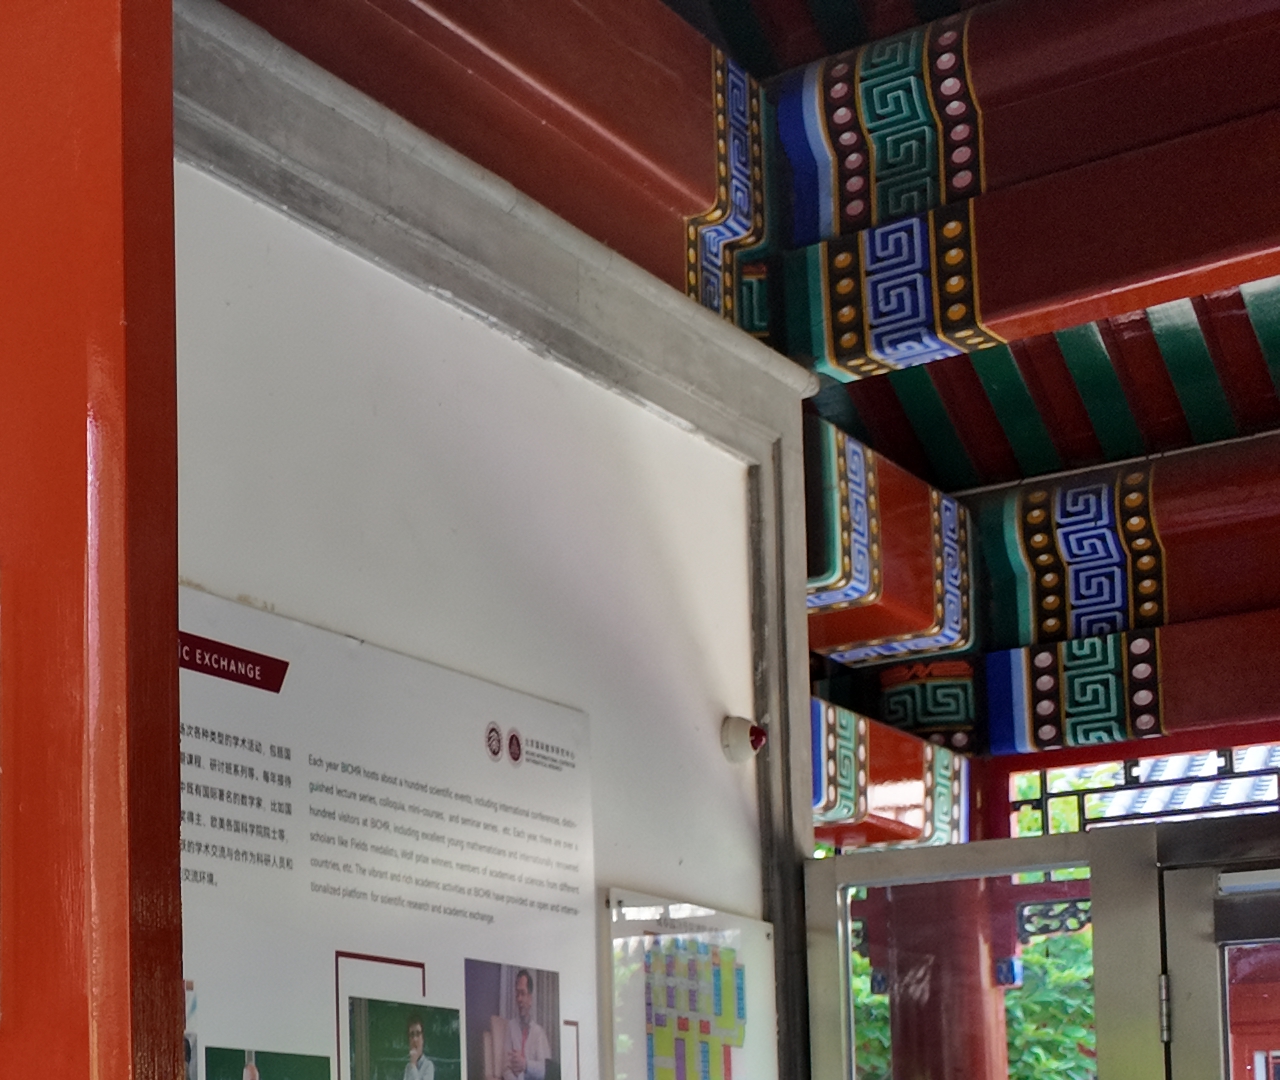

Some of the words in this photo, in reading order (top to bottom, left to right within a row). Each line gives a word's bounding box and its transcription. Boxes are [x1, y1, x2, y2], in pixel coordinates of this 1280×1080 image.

[195, 649, 262, 681] EXCHANGE
[309, 753, 324, 767] Each
[325, 761, 339, 772] year
